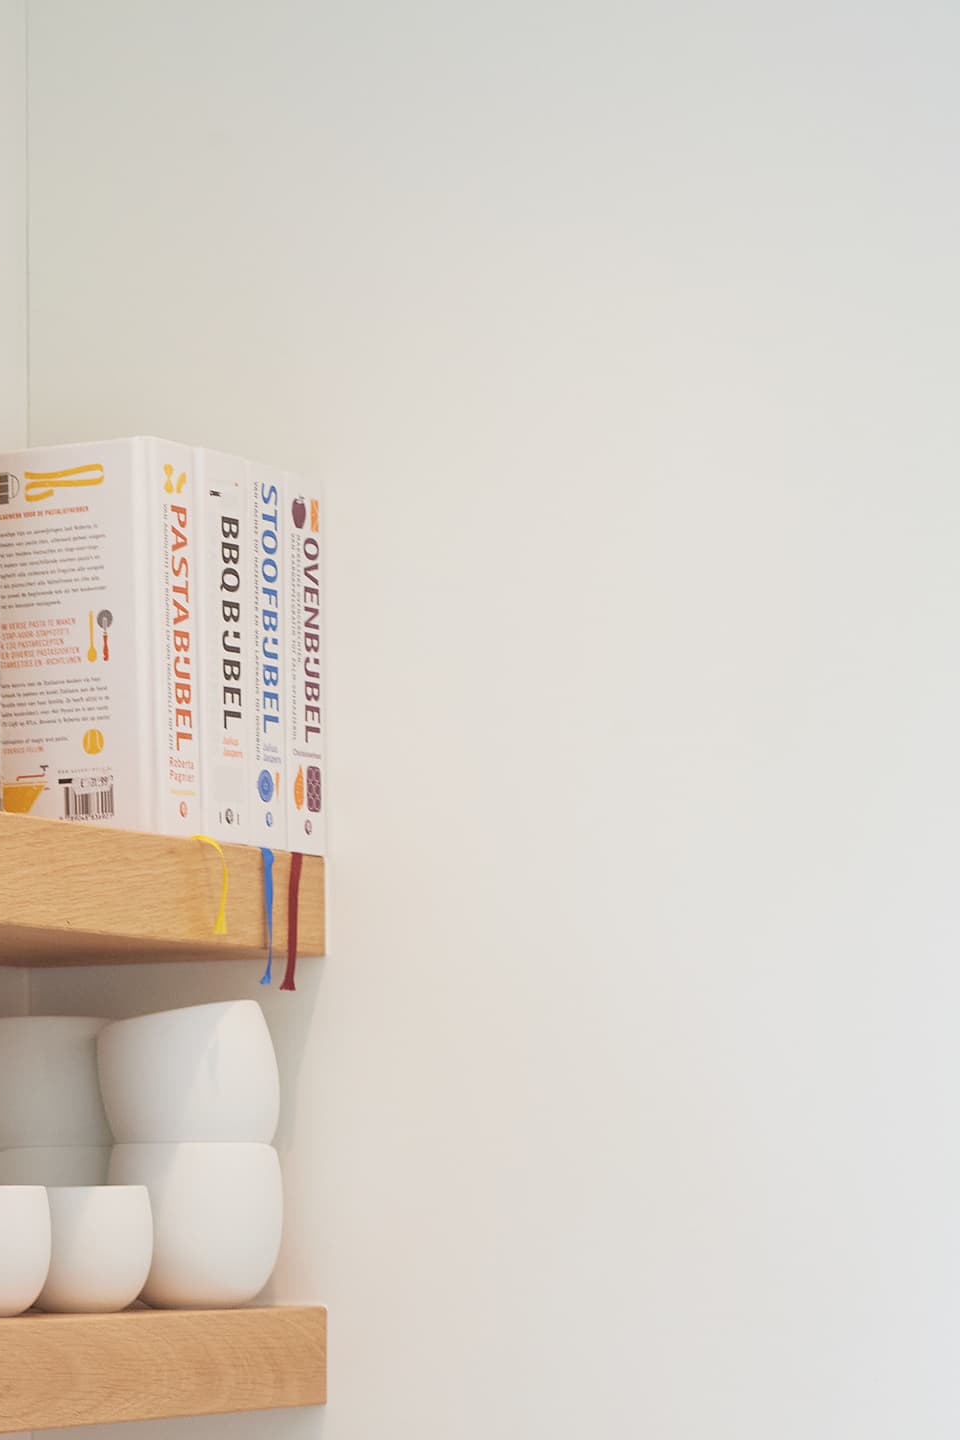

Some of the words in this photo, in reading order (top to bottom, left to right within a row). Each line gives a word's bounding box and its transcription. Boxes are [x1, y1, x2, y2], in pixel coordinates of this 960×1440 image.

[170, 504, 193, 751] PASTABIJBEL
[220, 516, 242, 593] BBQ
[261, 482, 280, 734] STOOFBIJBEL
[303, 537, 321, 744] OVENBIJBEL
